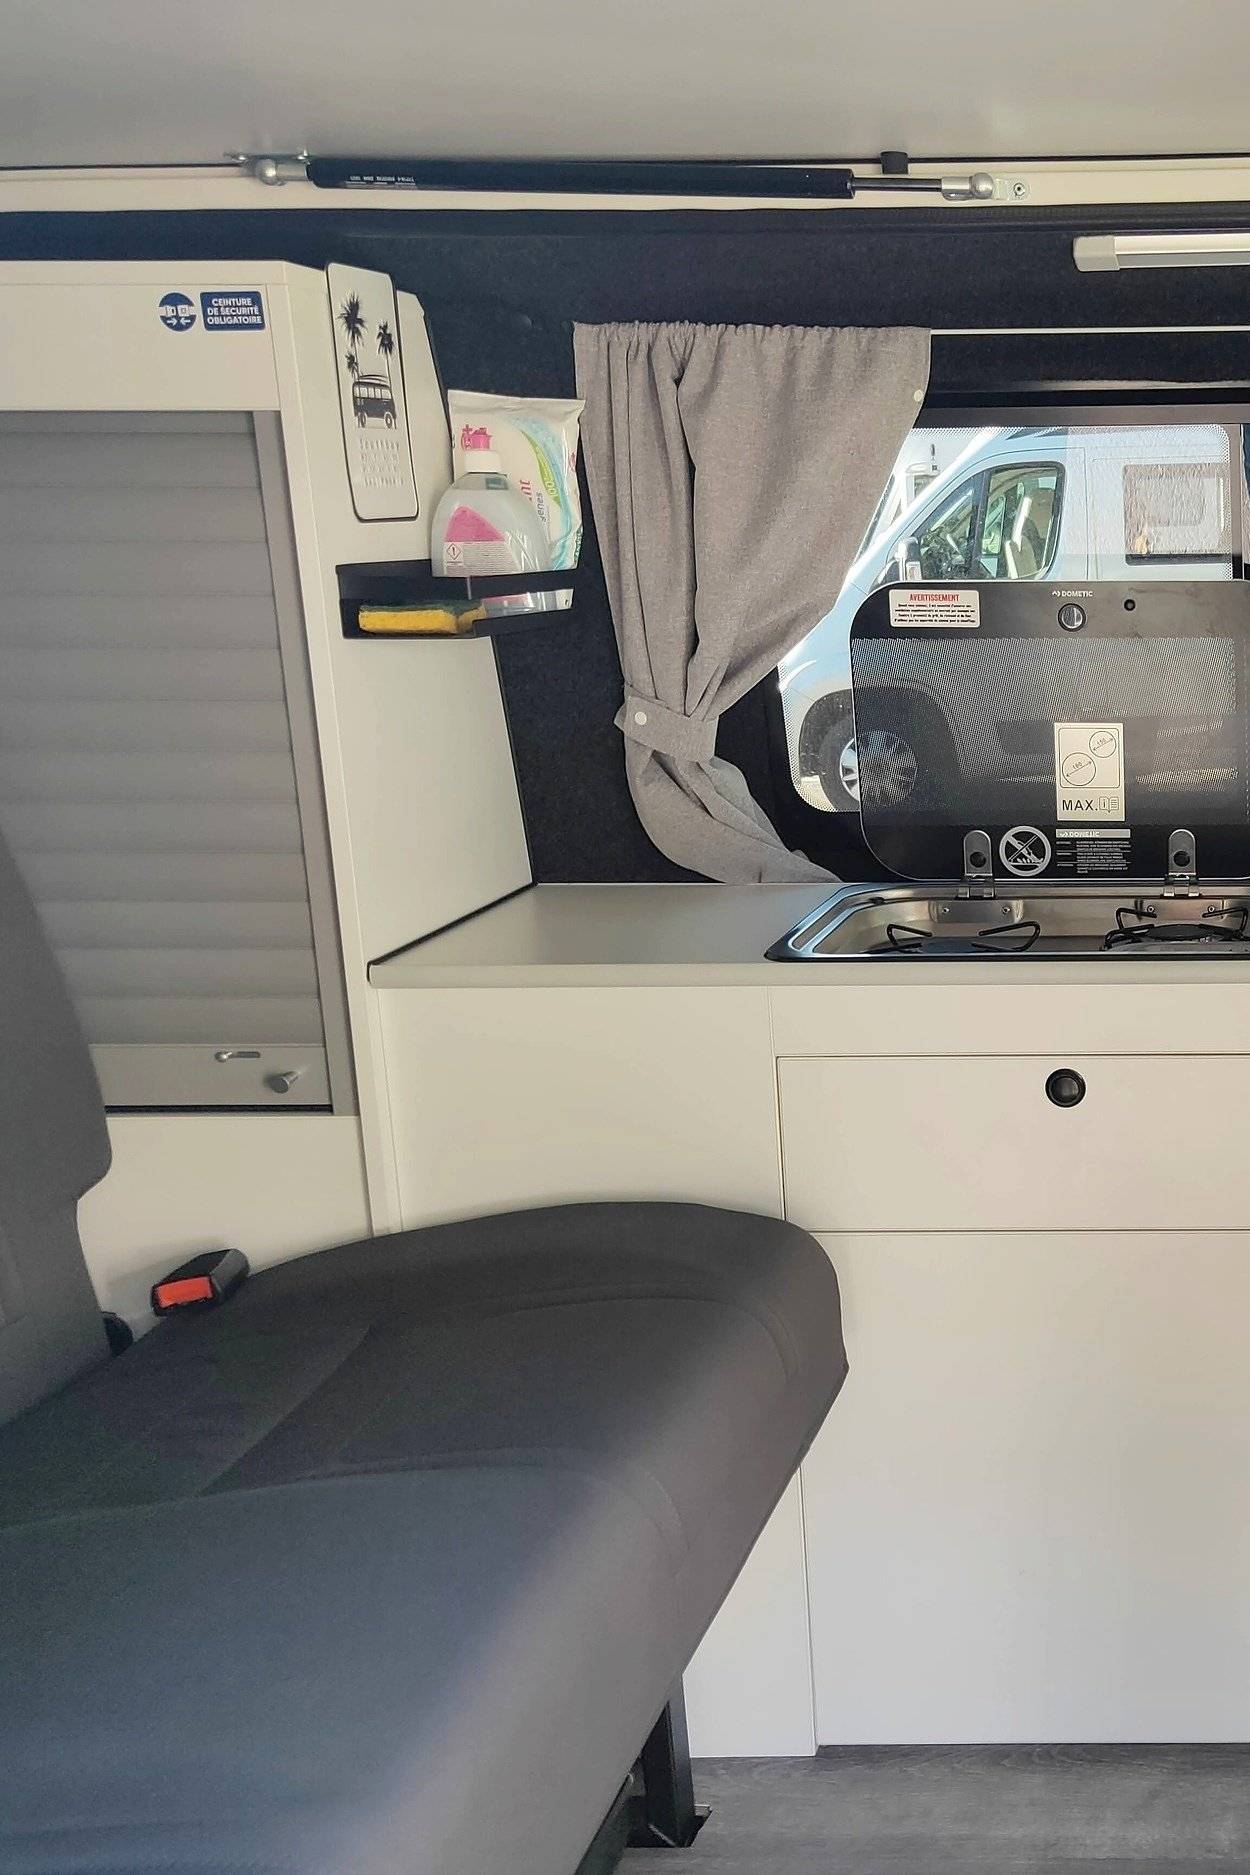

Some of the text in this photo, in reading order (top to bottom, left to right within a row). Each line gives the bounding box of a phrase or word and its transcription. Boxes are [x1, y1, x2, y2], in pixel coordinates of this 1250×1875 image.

[211, 298, 252, 306] CEINTURE
[207, 307, 219, 315] DE
[207, 316, 263, 324] OBLIGATOIRE
[909, 593, 960, 602] AVERTISSEMENT
[1062, 799, 1098, 811] MAX.
